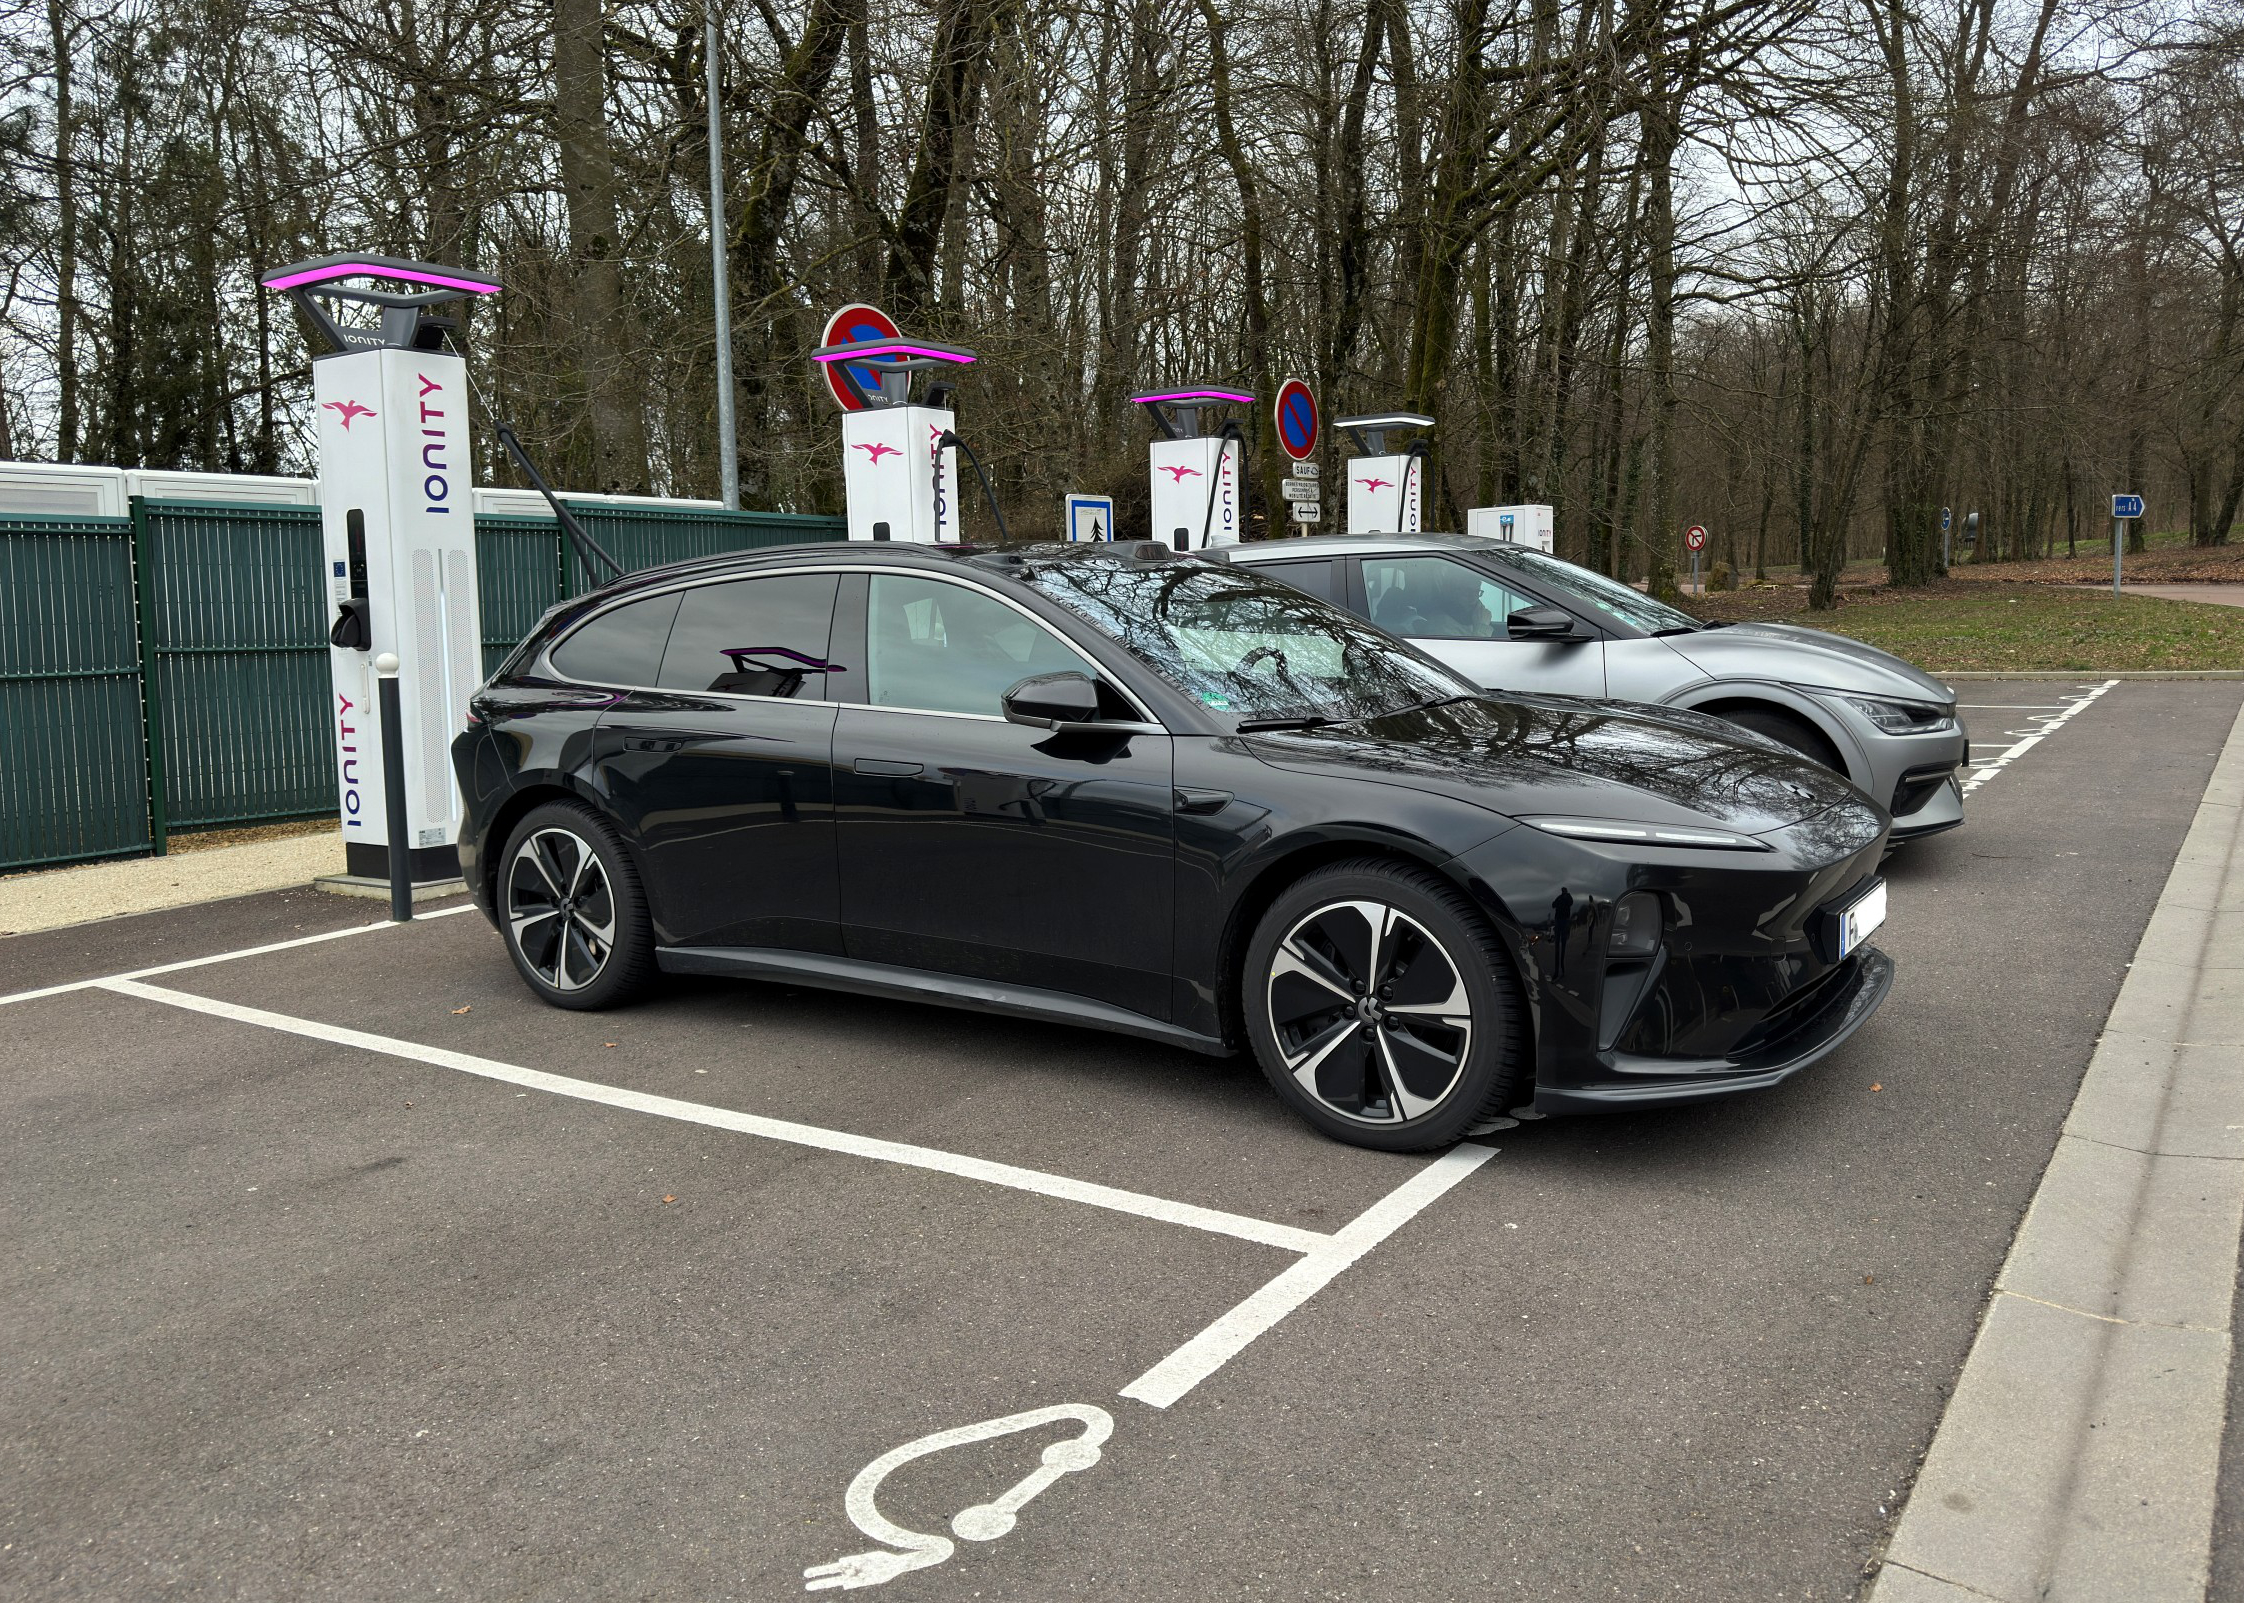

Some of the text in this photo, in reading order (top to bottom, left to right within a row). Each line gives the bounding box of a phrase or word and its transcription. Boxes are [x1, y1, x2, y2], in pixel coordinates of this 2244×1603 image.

[343, 334, 386, 346] IONITY
[418, 372, 450, 514] IONITY
[1296, 466, 1310, 474] SAUF
[1222, 451, 1232, 530] IONITY
[339, 692, 362, 827] IONITY
